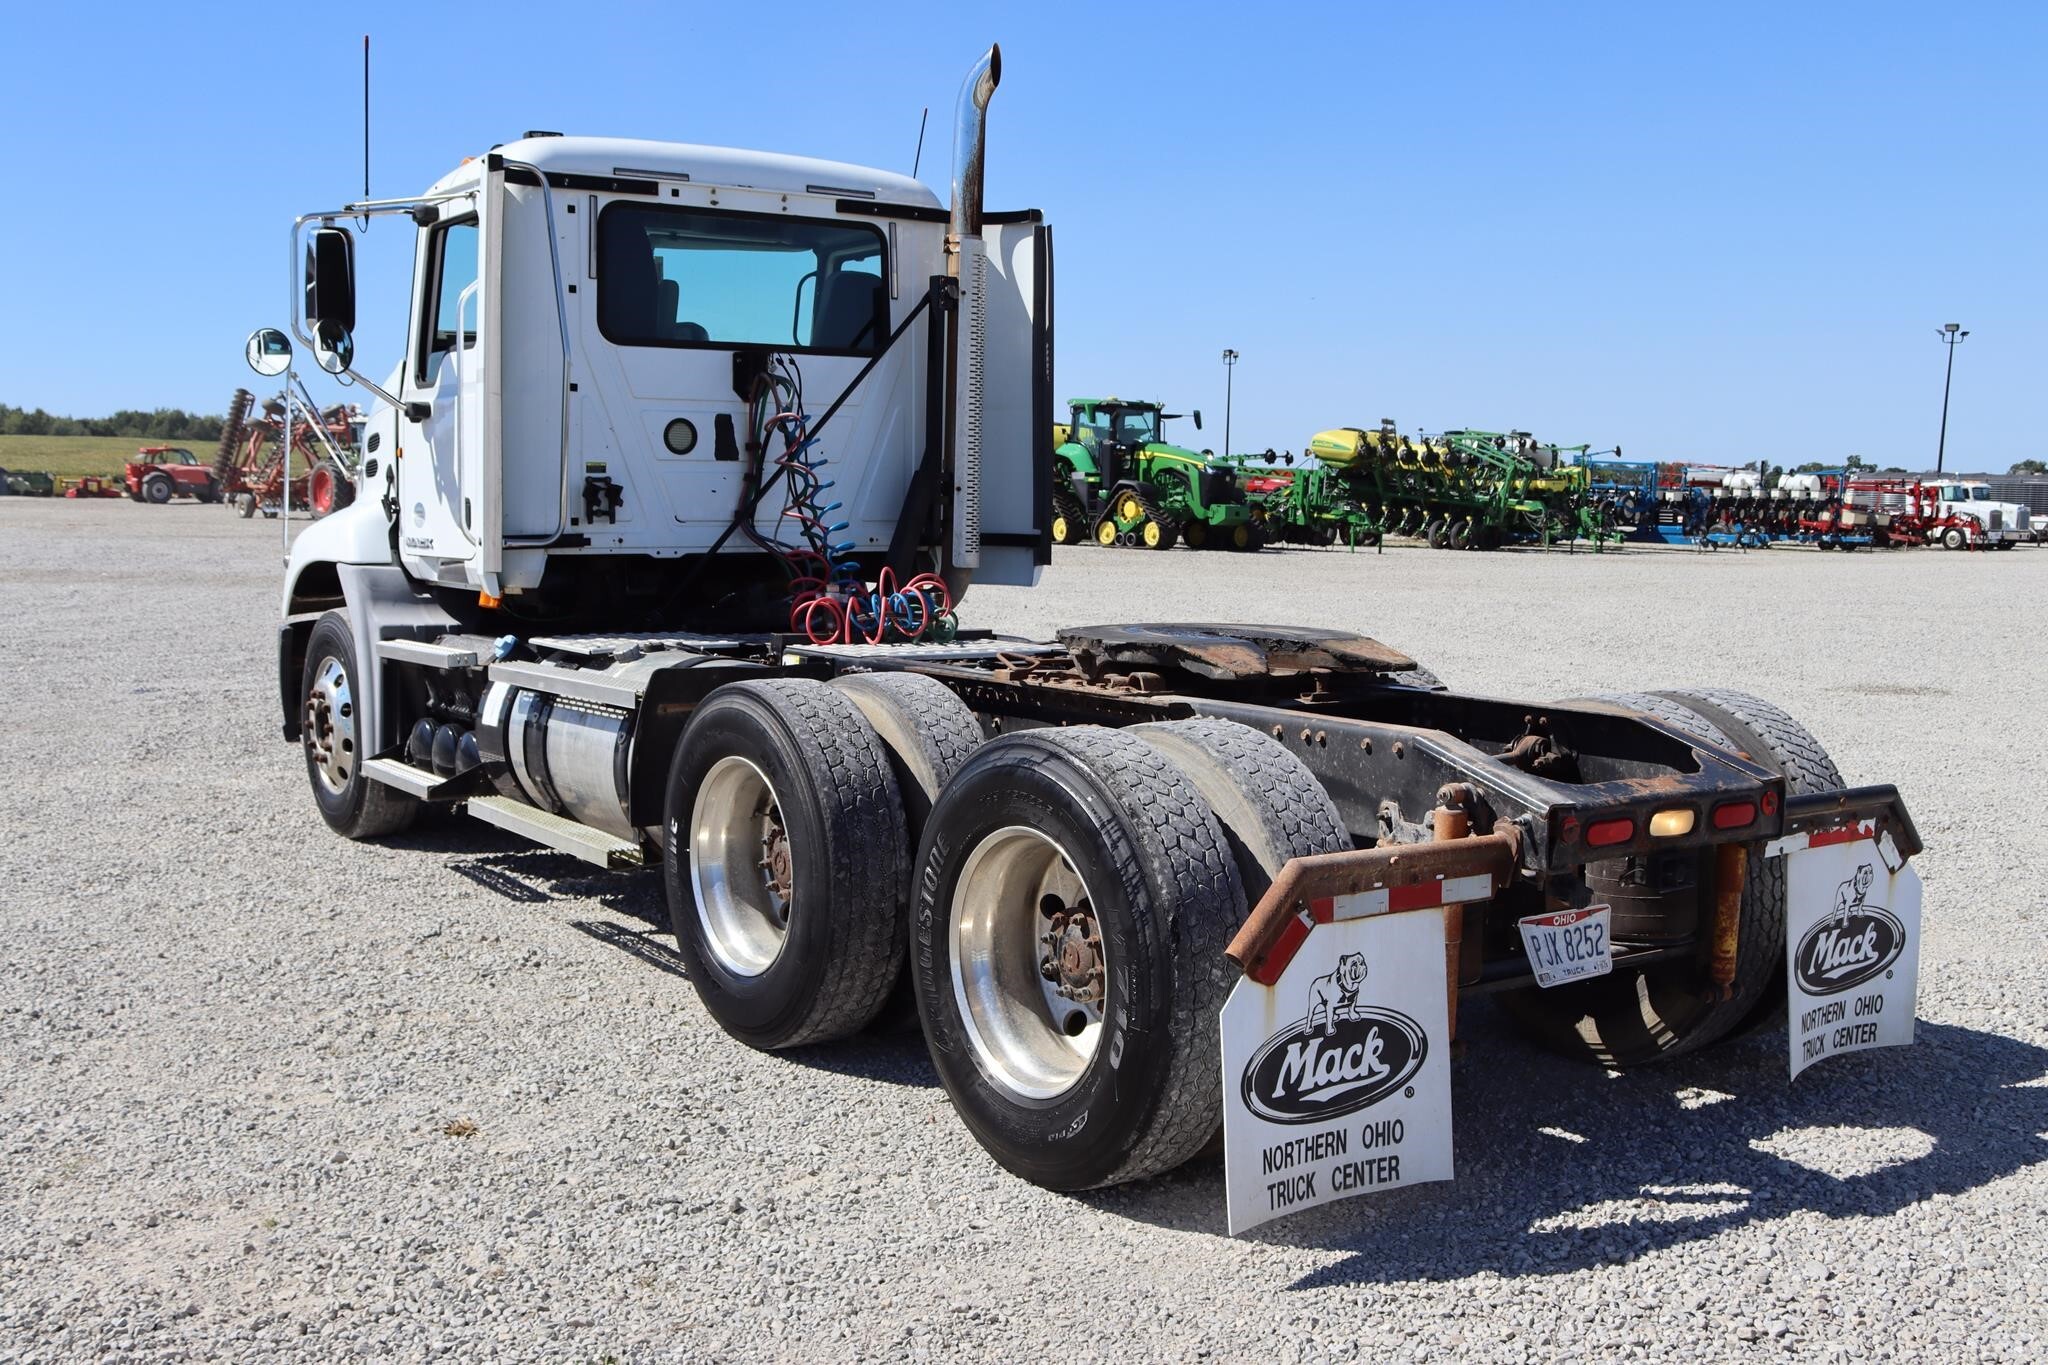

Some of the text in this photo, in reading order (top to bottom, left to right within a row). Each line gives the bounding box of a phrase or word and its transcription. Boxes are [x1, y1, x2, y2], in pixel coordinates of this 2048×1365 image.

[1553, 914, 1576, 926] OHIO
[1530, 923, 1604, 968] PJX 8252
[1808, 922, 1879, 979] Mack
[1562, 965, 1587, 977] TRUCK
[1801, 994, 1884, 1035] NORTHERN OHIO
[1272, 1026, 1391, 1102] Mack
[1802, 1022, 1878, 1063] TRUCK CENTER
[1263, 1118, 1405, 1175] NORTHERN OHIO
[1267, 1154, 1401, 1211] TRUCK CENTER
